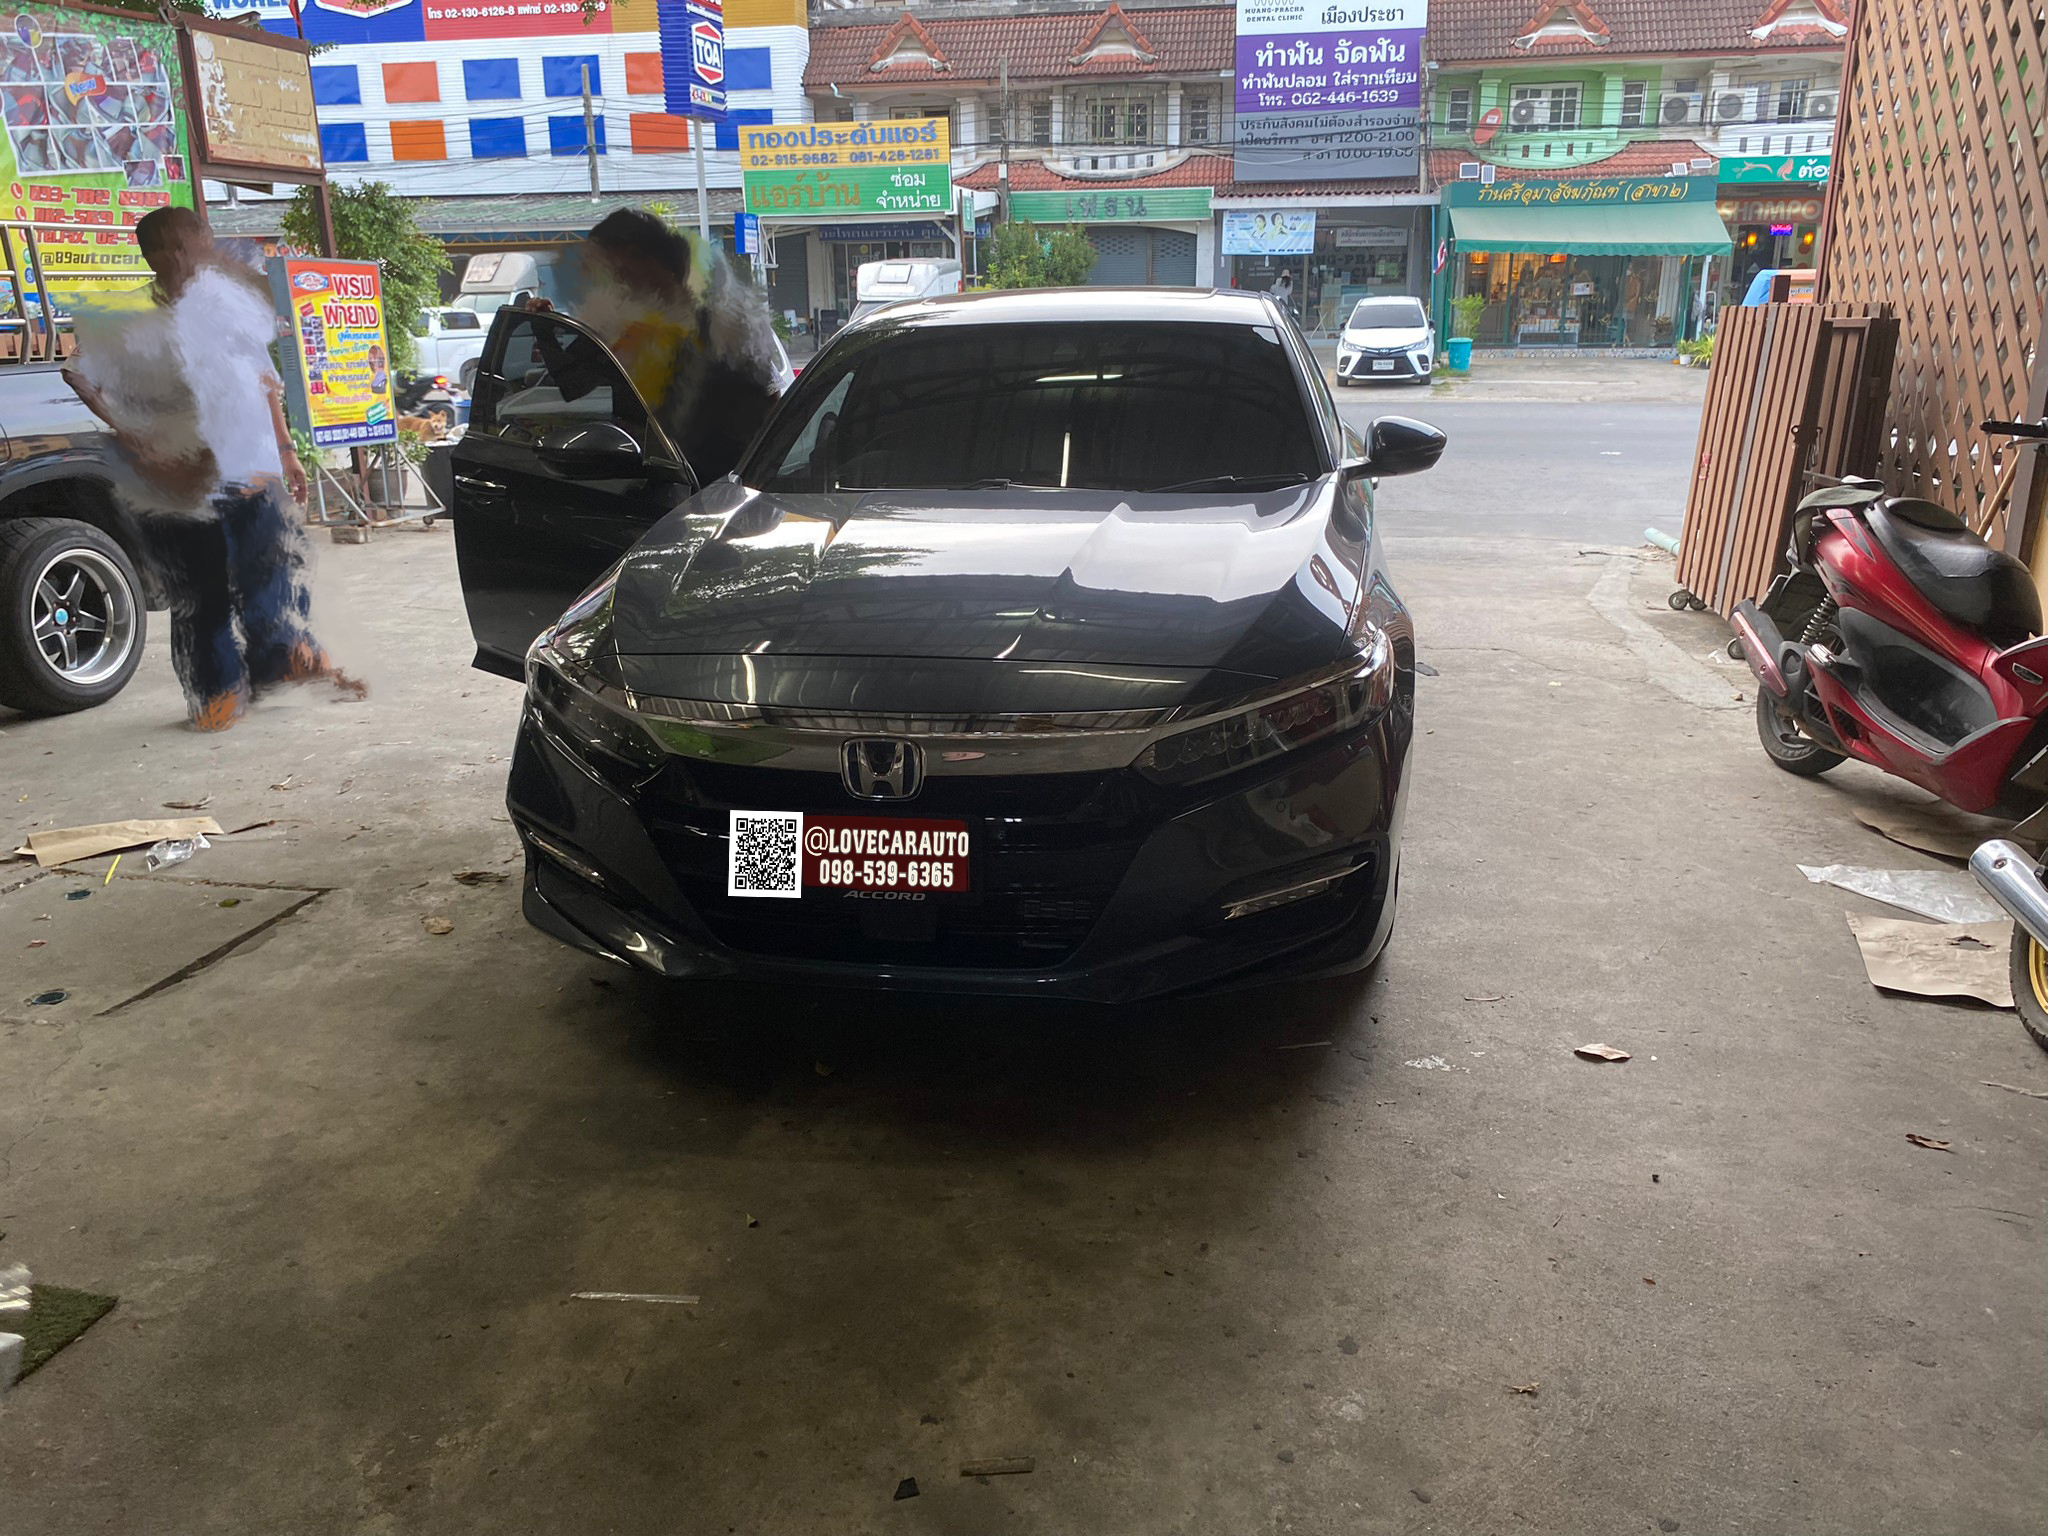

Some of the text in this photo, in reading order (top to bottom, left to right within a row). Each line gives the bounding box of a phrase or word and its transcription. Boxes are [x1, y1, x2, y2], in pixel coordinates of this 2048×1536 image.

[1245, 6, 1305, 14] MUANG-PRACHA
[1321, 6, 1404, 24] เมืองประชา
[696, 38, 721, 70] TOA
[1256, 37, 1406, 67] ทำฟัน จัดฟัน
[69, 78, 97, 95] New
[1242, 67, 1417, 90] ทำฟันปลอม ใส่รากเทียม
[1258, 90, 1398, 106] โทร. 062-446-1639
[1240, 114, 1415, 130] ประกันสังคมไม่ต้องสำรองจ่าย
[890, 167, 926, 187] ซ่อม
[1798, 158, 1830, 178] ต้อ
[751, 171, 861, 208] แอร์บ้าน
[876, 189, 941, 209] จำหน่าย
[332, 275, 374, 298] พรม
[323, 298, 379, 326] ผ้ายาง
[843, 890, 926, 901] ACCORD
